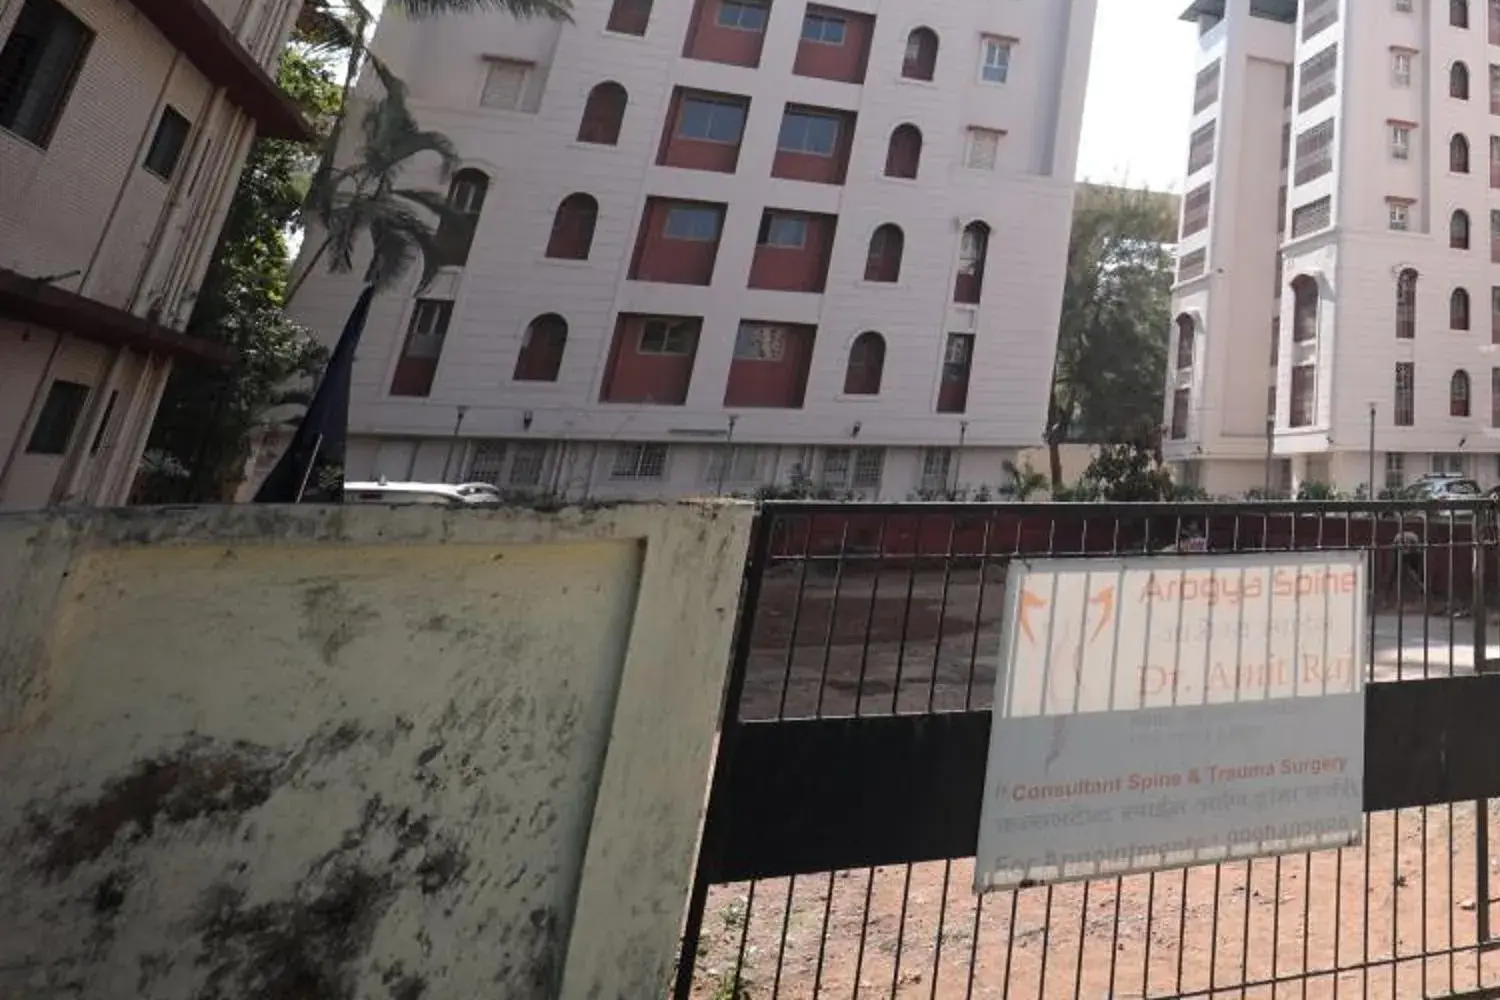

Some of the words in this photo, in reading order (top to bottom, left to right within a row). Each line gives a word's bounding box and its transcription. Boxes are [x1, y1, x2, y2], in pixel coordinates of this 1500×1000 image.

[1139, 574, 1262, 604] Arogya
[1273, 569, 1357, 599] Spine
[1137, 663, 1191, 694] Dr.
[1210, 652, 1287, 690] Amit
[1012, 776, 1120, 801] Consultant
[1127, 771, 1181, 794] Spine
[1187, 767, 1201, 784] &
[1208, 763, 1275, 783] Trauma
[1280, 756, 1347, 777] Surgery
